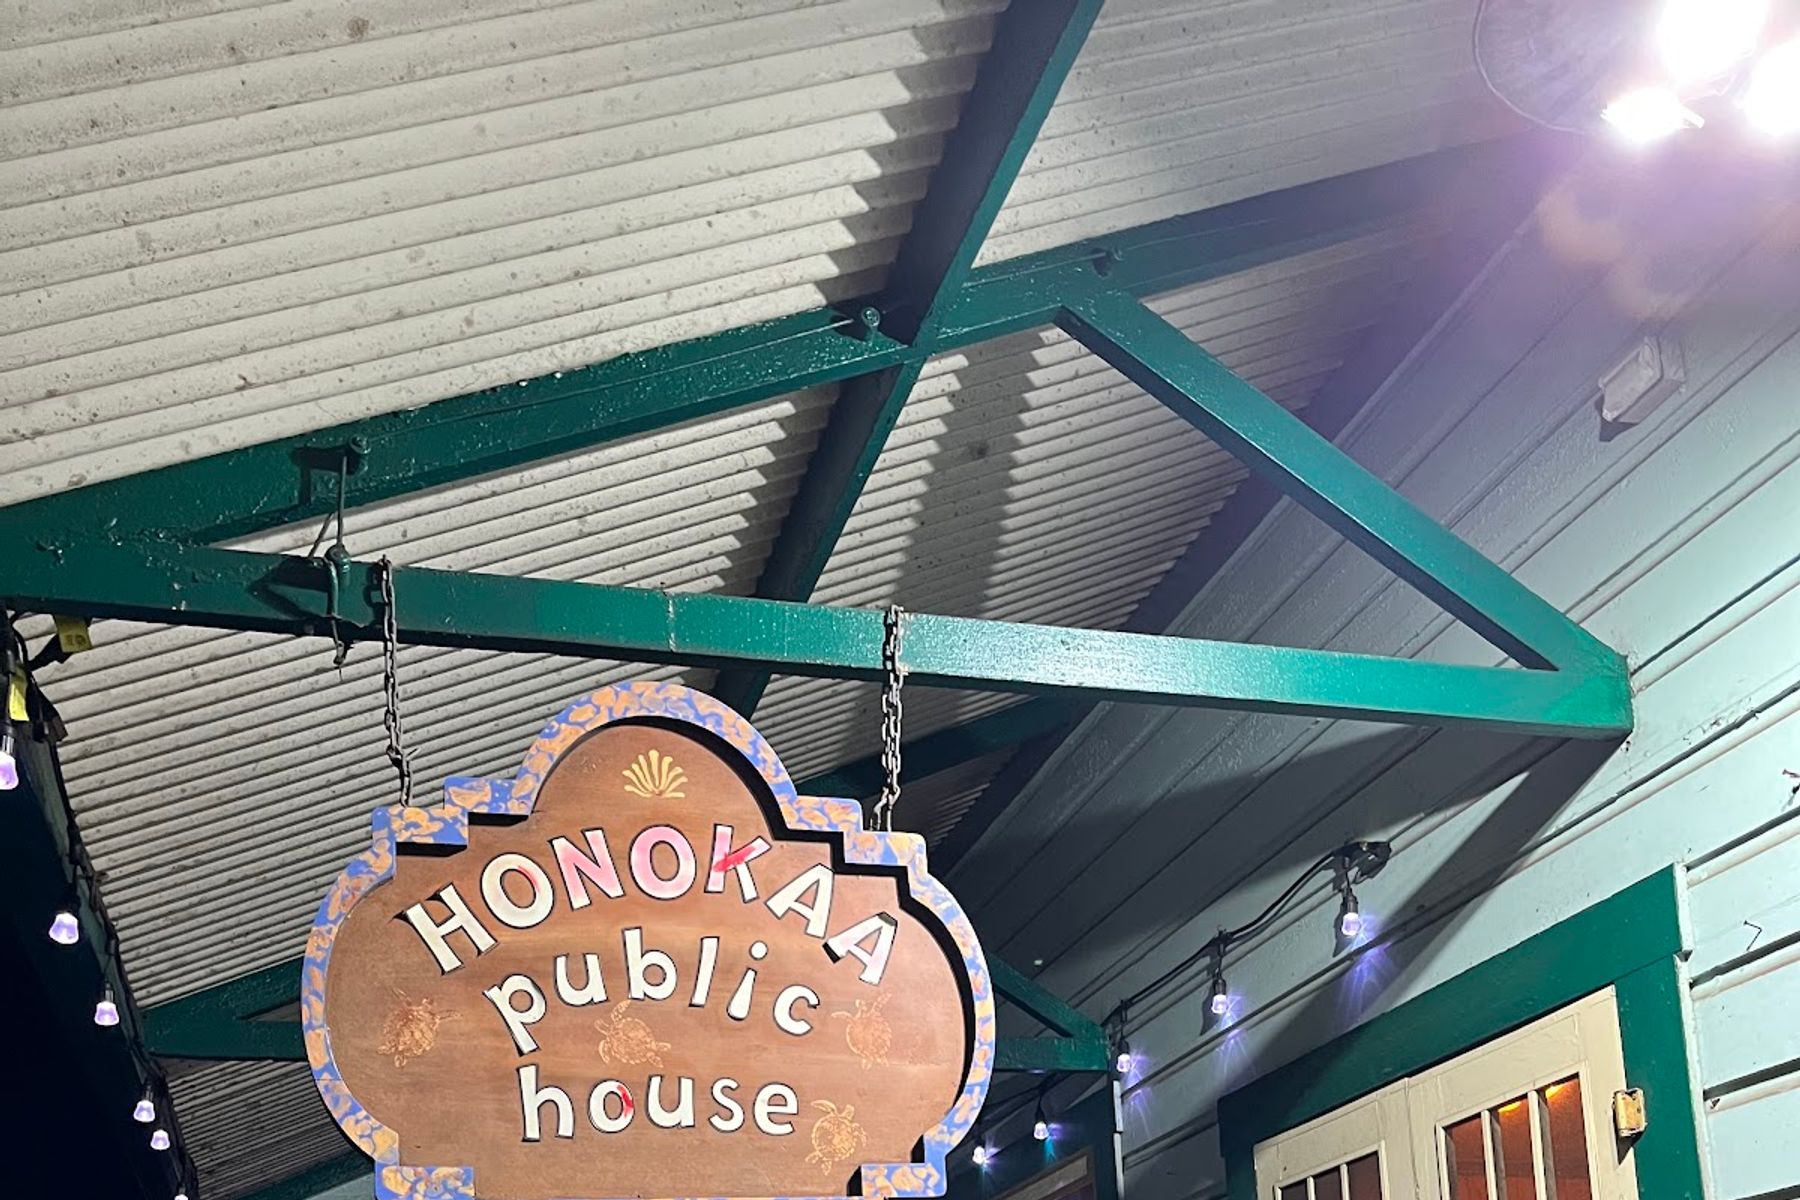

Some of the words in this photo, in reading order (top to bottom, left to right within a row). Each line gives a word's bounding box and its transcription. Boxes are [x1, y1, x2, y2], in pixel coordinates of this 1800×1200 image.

[404, 823, 899, 986] HONOKAA
[485, 926, 820, 1055] public
[517, 1062, 800, 1143] house
